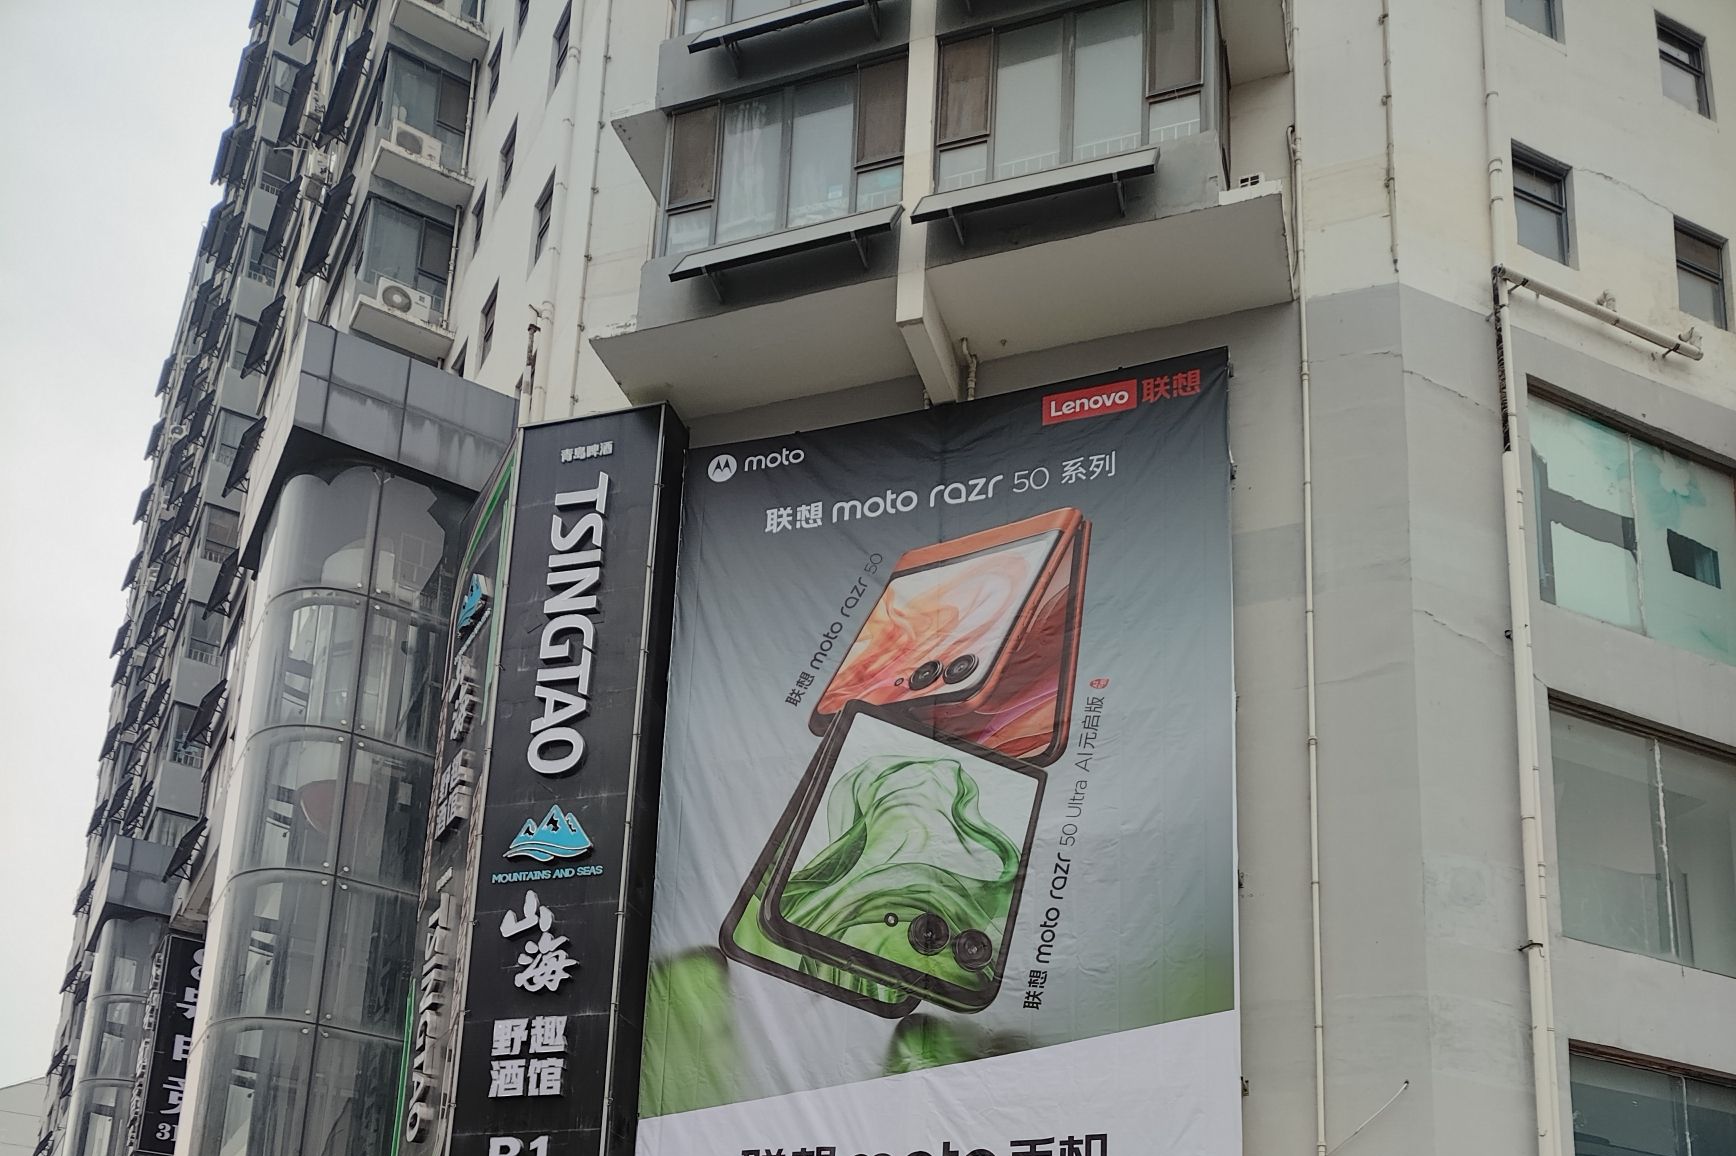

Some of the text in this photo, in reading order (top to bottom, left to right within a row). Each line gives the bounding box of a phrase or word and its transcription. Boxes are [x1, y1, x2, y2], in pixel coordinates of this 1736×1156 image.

[1049, 390, 1130, 418] Lenovo
[1141, 369, 1201, 403] 联想
[743, 446, 805, 473] moto
[764, 450, 1117, 534] 联想 moto razr 50 系列
[527, 471, 610, 778] TSINGTAO
[785, 553, 883, 707] 联想 moto razr 50
[1065, 779, 1088, 818] Ultra
[1059, 823, 1077, 847] 50
[491, 865, 604, 884] MOUNTAINS AND SEAS
[1050, 851, 1071, 900] razr
[500, 890, 580, 993] 山海
[1036, 906, 1061, 964] moto
[1022, 969, 1048, 1010] 联想
[406, 892, 452, 1144] TSINGTAO
[492, 1015, 568, 1057] 野趣
[488, 1057, 567, 1098] 酒馆
